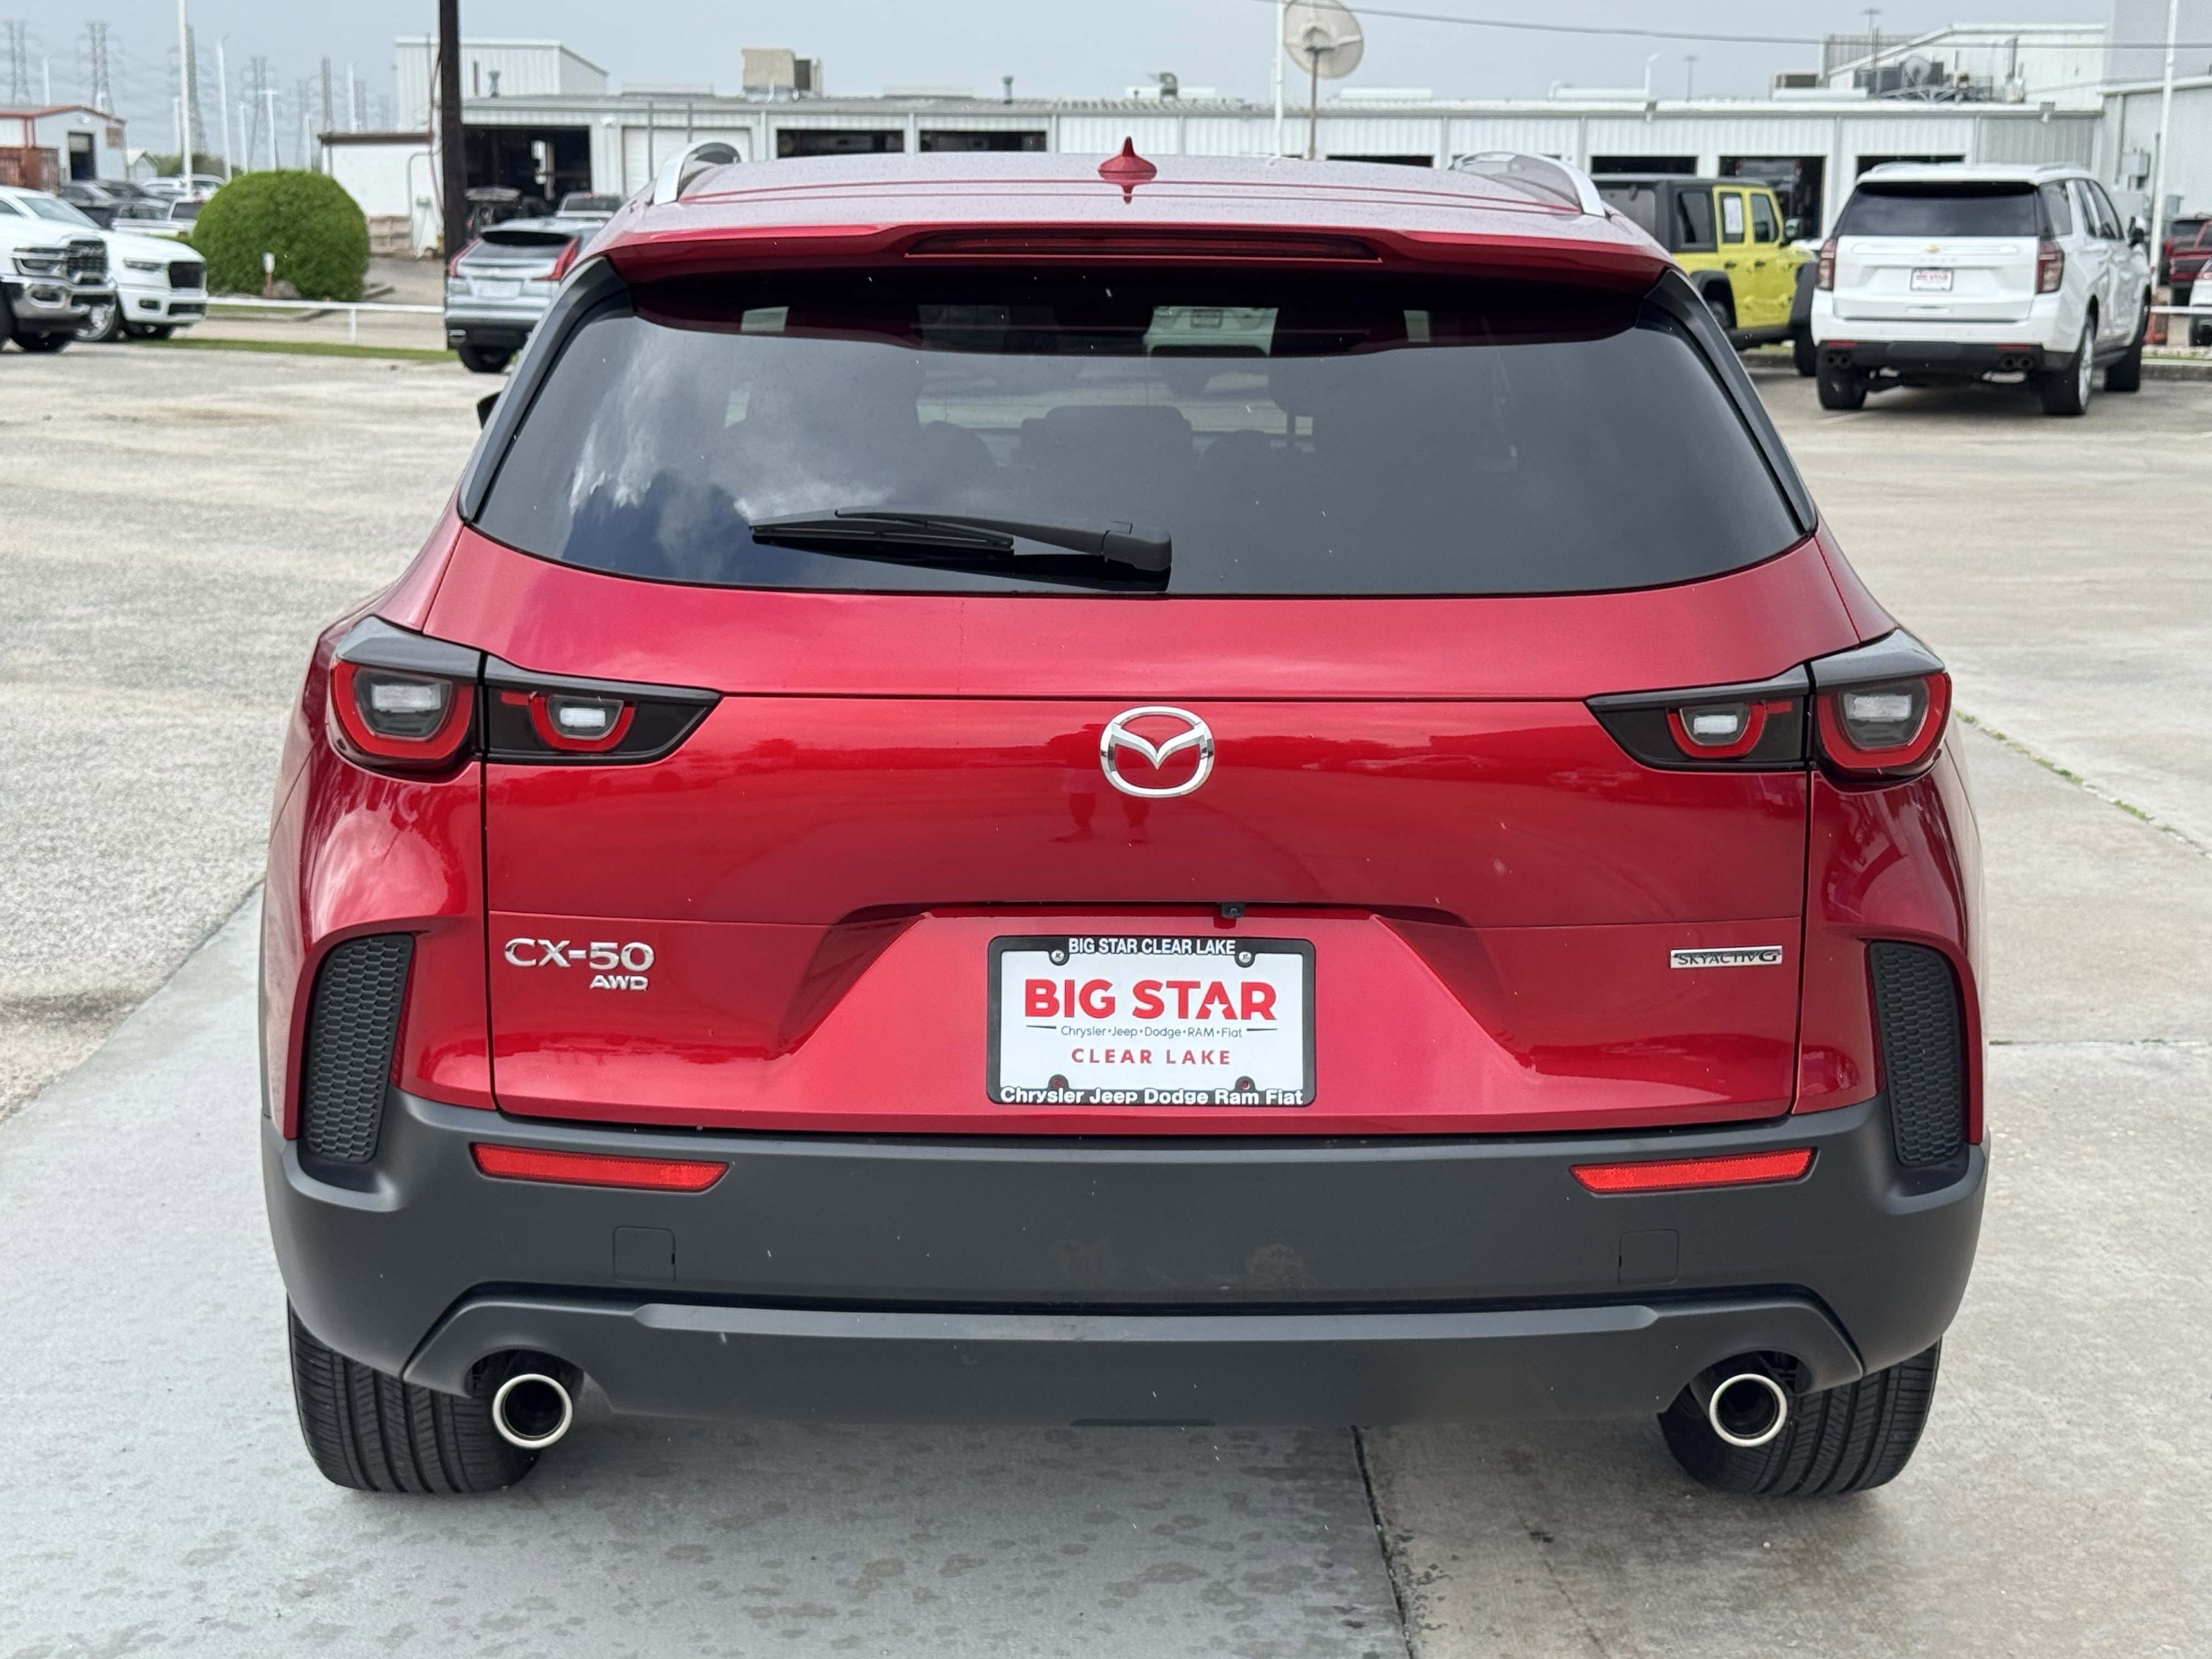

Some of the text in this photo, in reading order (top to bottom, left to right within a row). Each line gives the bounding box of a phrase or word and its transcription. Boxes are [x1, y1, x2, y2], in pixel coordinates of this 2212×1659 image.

[505, 938, 654, 972] CX-50
[1069, 938, 1236, 955] BIG STAR CLEAR LAKE
[589, 974, 649, 991] AWD
[1025, 979, 1277, 1020] BIG STAR
[1071, 1048, 1230, 1065] CLEAR LAKE
[1000, 1086, 1304, 1105] Chrysler Jeep Dodge Ram Fiat
